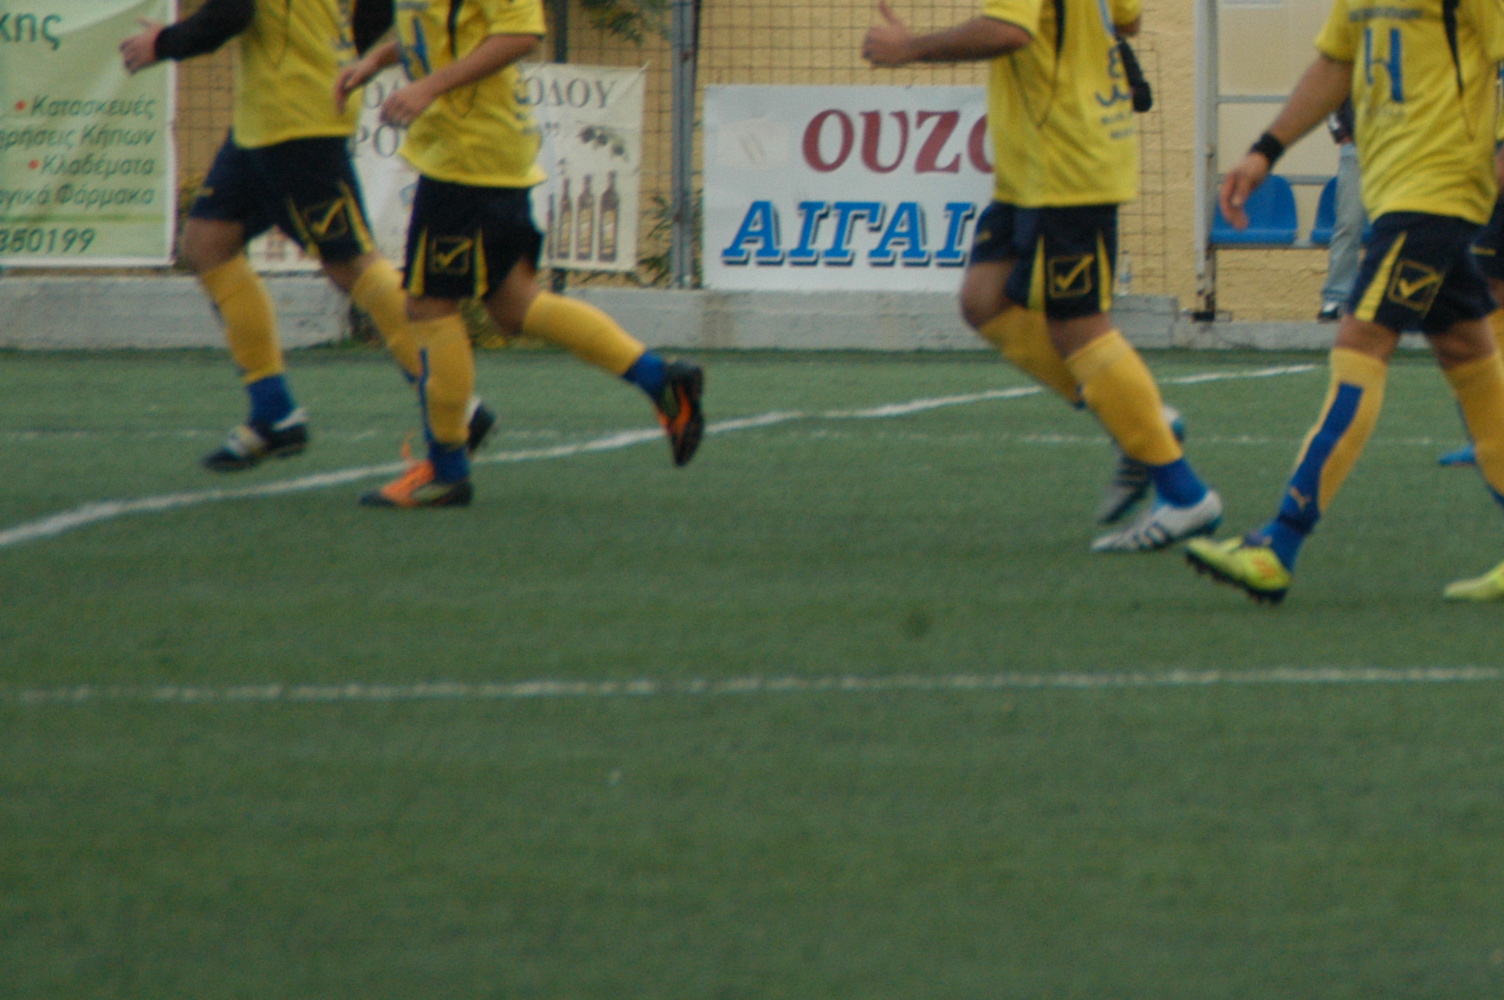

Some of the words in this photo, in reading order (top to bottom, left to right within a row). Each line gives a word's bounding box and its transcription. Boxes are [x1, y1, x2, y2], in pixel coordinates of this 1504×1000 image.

[31, 95, 156, 120] Κατασκευές
[81, 123, 156, 149] Κήπων
[41, 153, 156, 180] Κλαδέματα
[56, 182, 155, 210] Φάρμακα
[721, 200, 977, 268] ΑΙΓΑΙ
